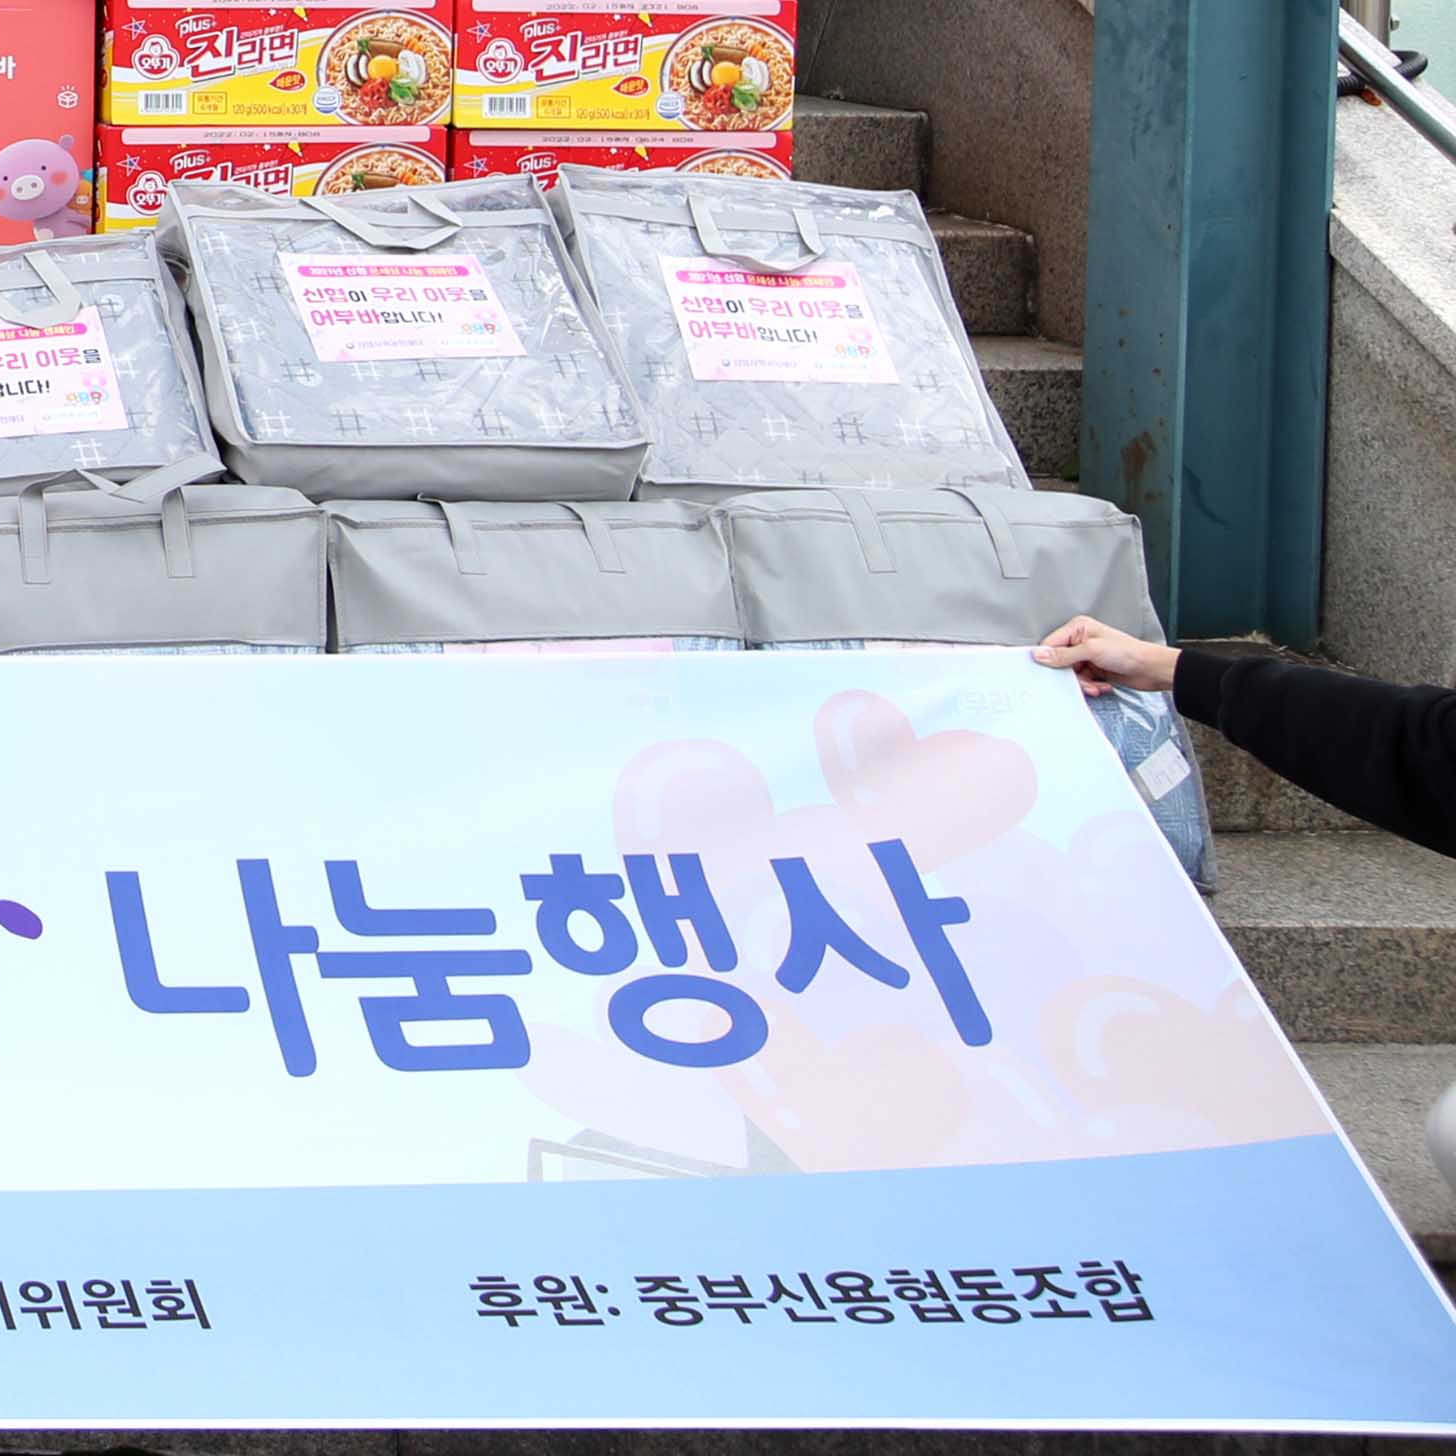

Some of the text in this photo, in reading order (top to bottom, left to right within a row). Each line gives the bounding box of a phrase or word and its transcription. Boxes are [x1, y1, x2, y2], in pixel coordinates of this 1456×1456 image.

[185, 28, 299, 80] 진라면
[529, 33, 643, 85] 진라면
[303, 287, 488, 304] 신협이 우리 이웃을
[311, 309, 444, 327] 어부바합니다!
[681, 296, 864, 320] 신협이 우리 이웃을
[689, 320, 818, 344] 어부바합니다!
[35, 347, 101, 367] 이웃을
[105, 837, 993, 1078] 나눔행사
[468, 1259, 1157, 1328] 후원: 중부신용협동조합
